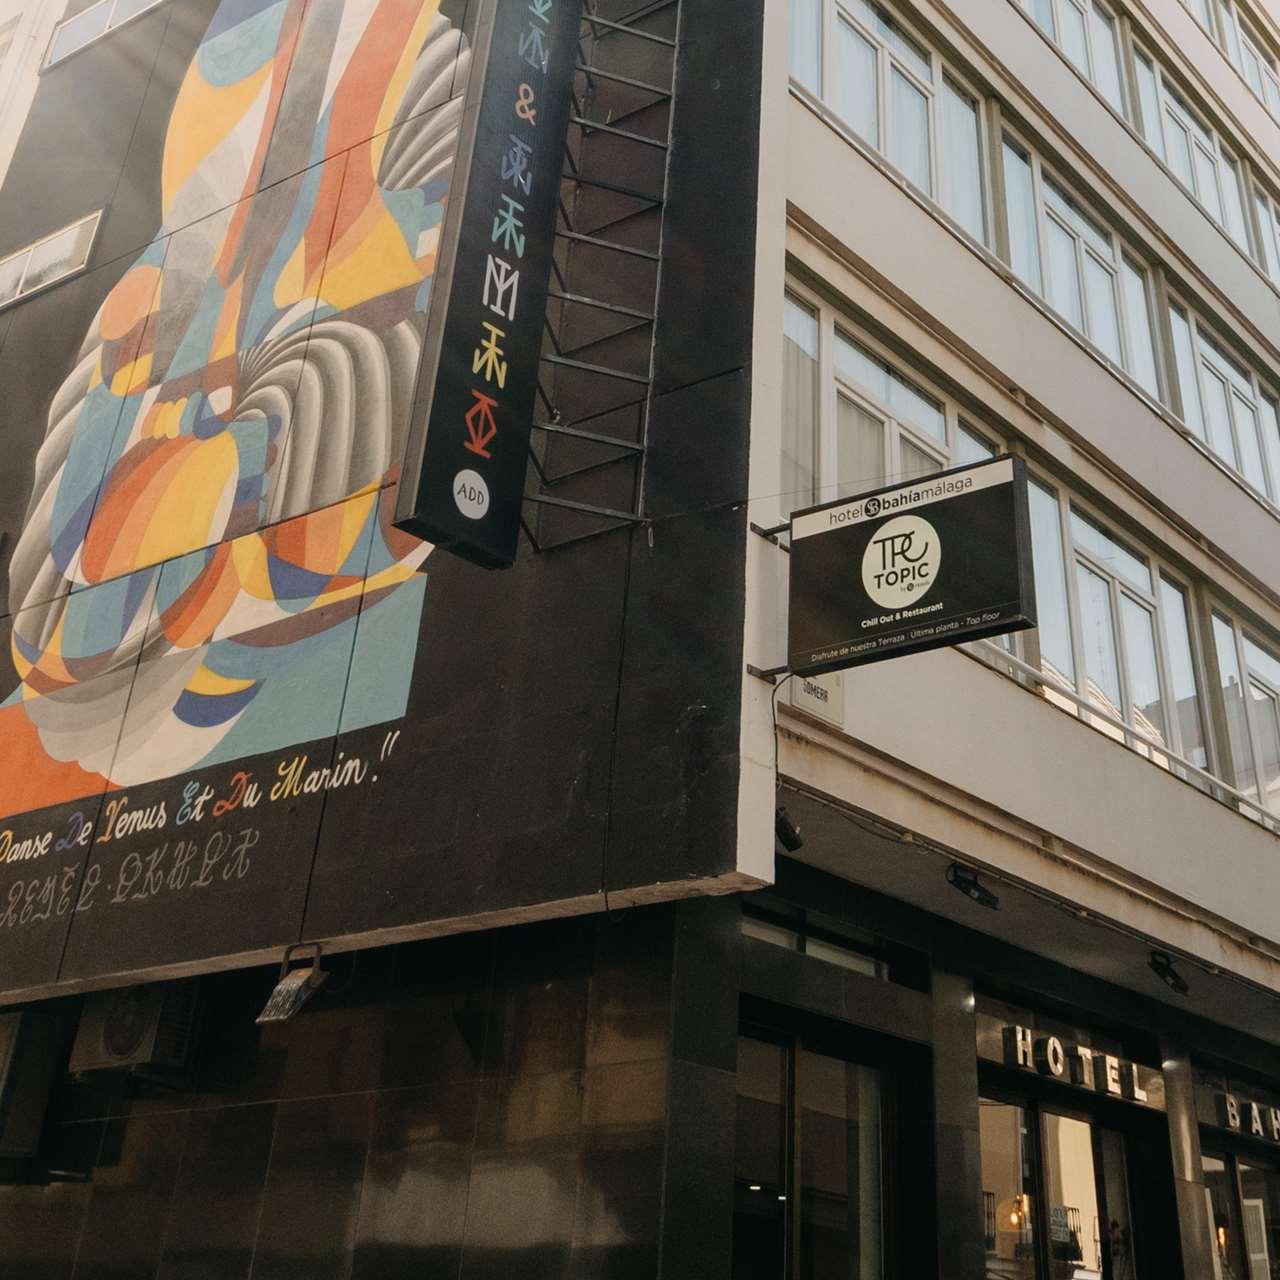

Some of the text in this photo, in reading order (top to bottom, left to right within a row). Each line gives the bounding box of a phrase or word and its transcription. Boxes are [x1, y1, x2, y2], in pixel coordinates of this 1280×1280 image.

[457, 483, 484, 505] ADD
[829, 504, 863, 525] hotel
[874, 563, 929, 589] TOPIC
[860, 602, 944, 629] Chill Out & Restaurant
[839, 647, 849, 656] de
[850, 641, 877, 653] nuestra
[935, 621, 959, 637] planta
[55, 811, 93, 851] De
[96, 796, 168, 844] Venus
[175, 780, 215, 825] Et
[212, 771, 263, 816] Du
[1014, 1025, 1148, 1102] HOTEL
